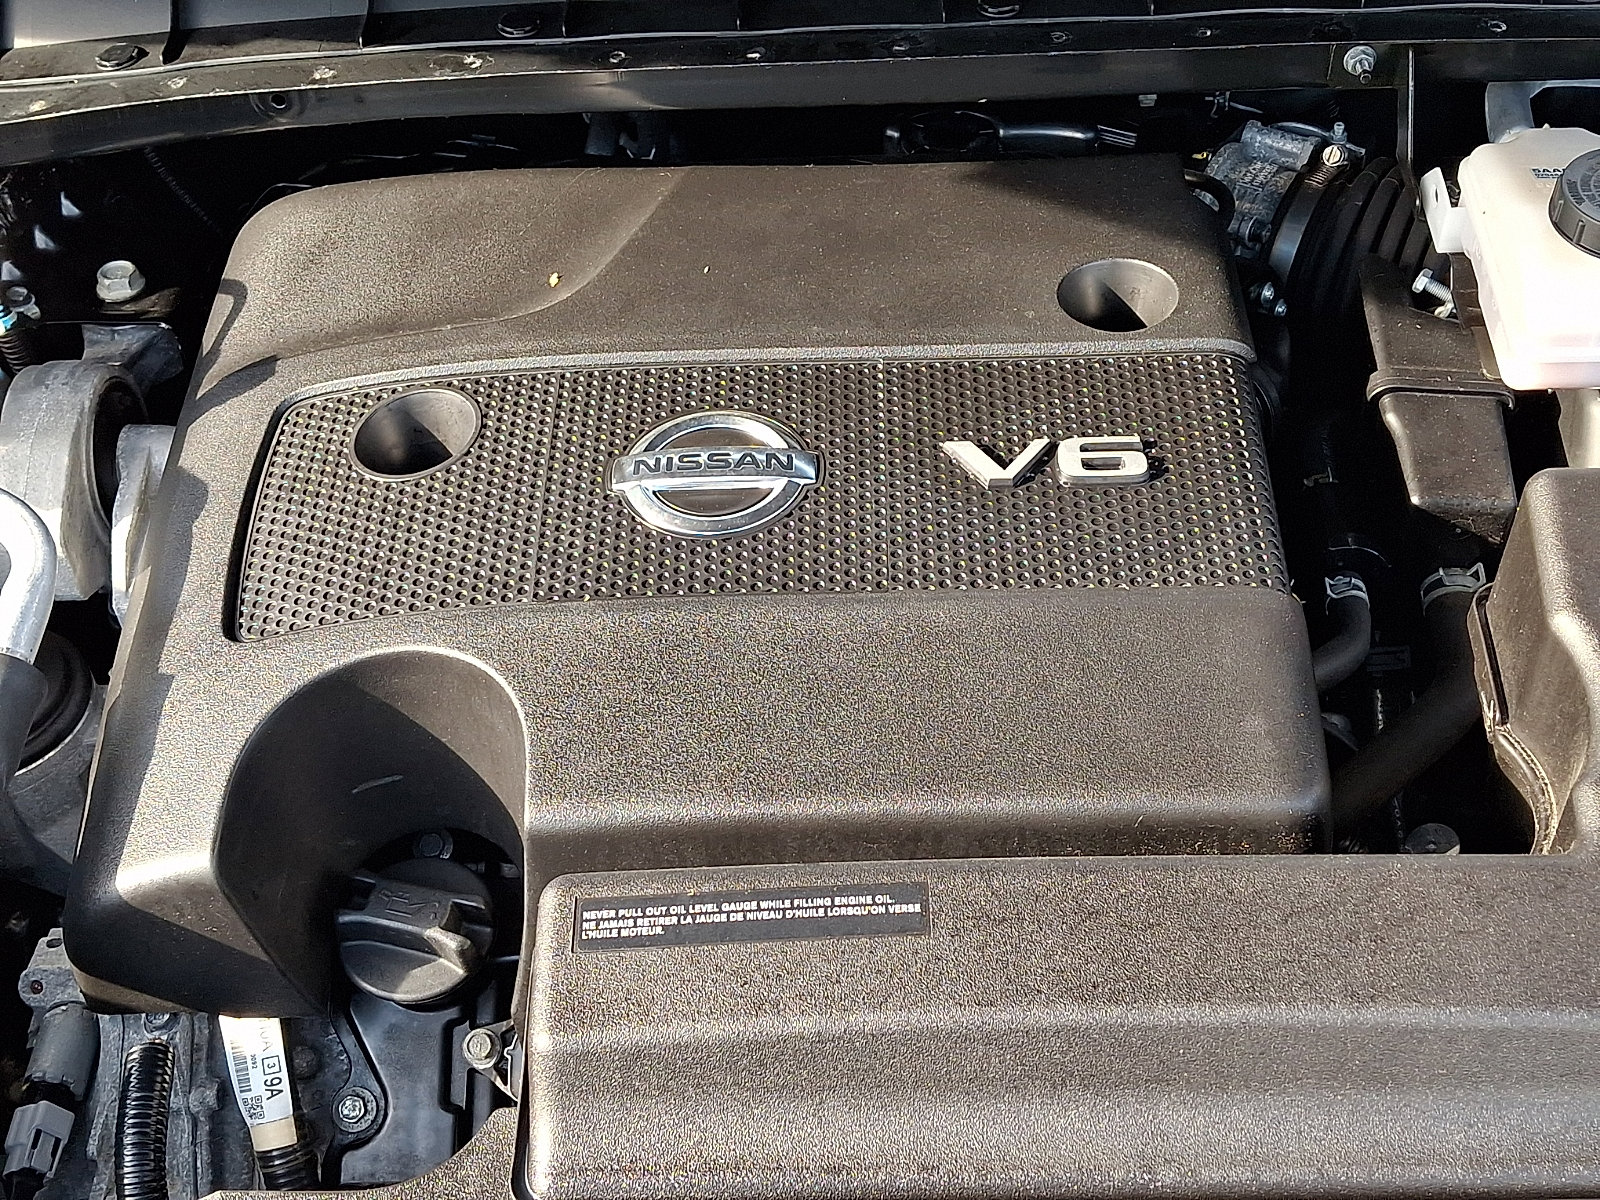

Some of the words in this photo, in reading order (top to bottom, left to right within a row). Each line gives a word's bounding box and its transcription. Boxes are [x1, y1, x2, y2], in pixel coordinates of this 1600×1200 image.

[632, 451, 795, 476] NISSAN
[942, 435, 1149, 489] V6
[582, 909, 616, 920] NEVER
[618, 907, 643, 918] PULL
[645, 907, 668, 917] OUT
[669, 905, 687, 915] OIL
[688, 903, 719, 914] LEVEL
[721, 901, 758, 911] GAUGE
[760, 899, 791, 910] WHILE
[793, 897, 832, 907] FILLING
[834, 895, 873, 905] ENGINE
[874, 894, 896, 904] OIL.
[582, 920, 597, 930] NE
[599, 918, 635, 929] JAMAIS
[636, 916, 679, 927] RETIRER
[680, 915, 693, 925] LA
[695, 913, 728, 924] JAUGE
[729, 912, 744, 922] DE
[746, 909, 783, 921] NIVEAU
[785, 907, 825, 919] D'HUILE
[827, 904, 886, 917] LORSQU'ON
[888, 903, 921, 914] VERSE
[581, 929, 619, 940] L'HUILE
[620, 926, 665, 938] MOTEUR.
[263, 1077, 284, 1101] 9A
